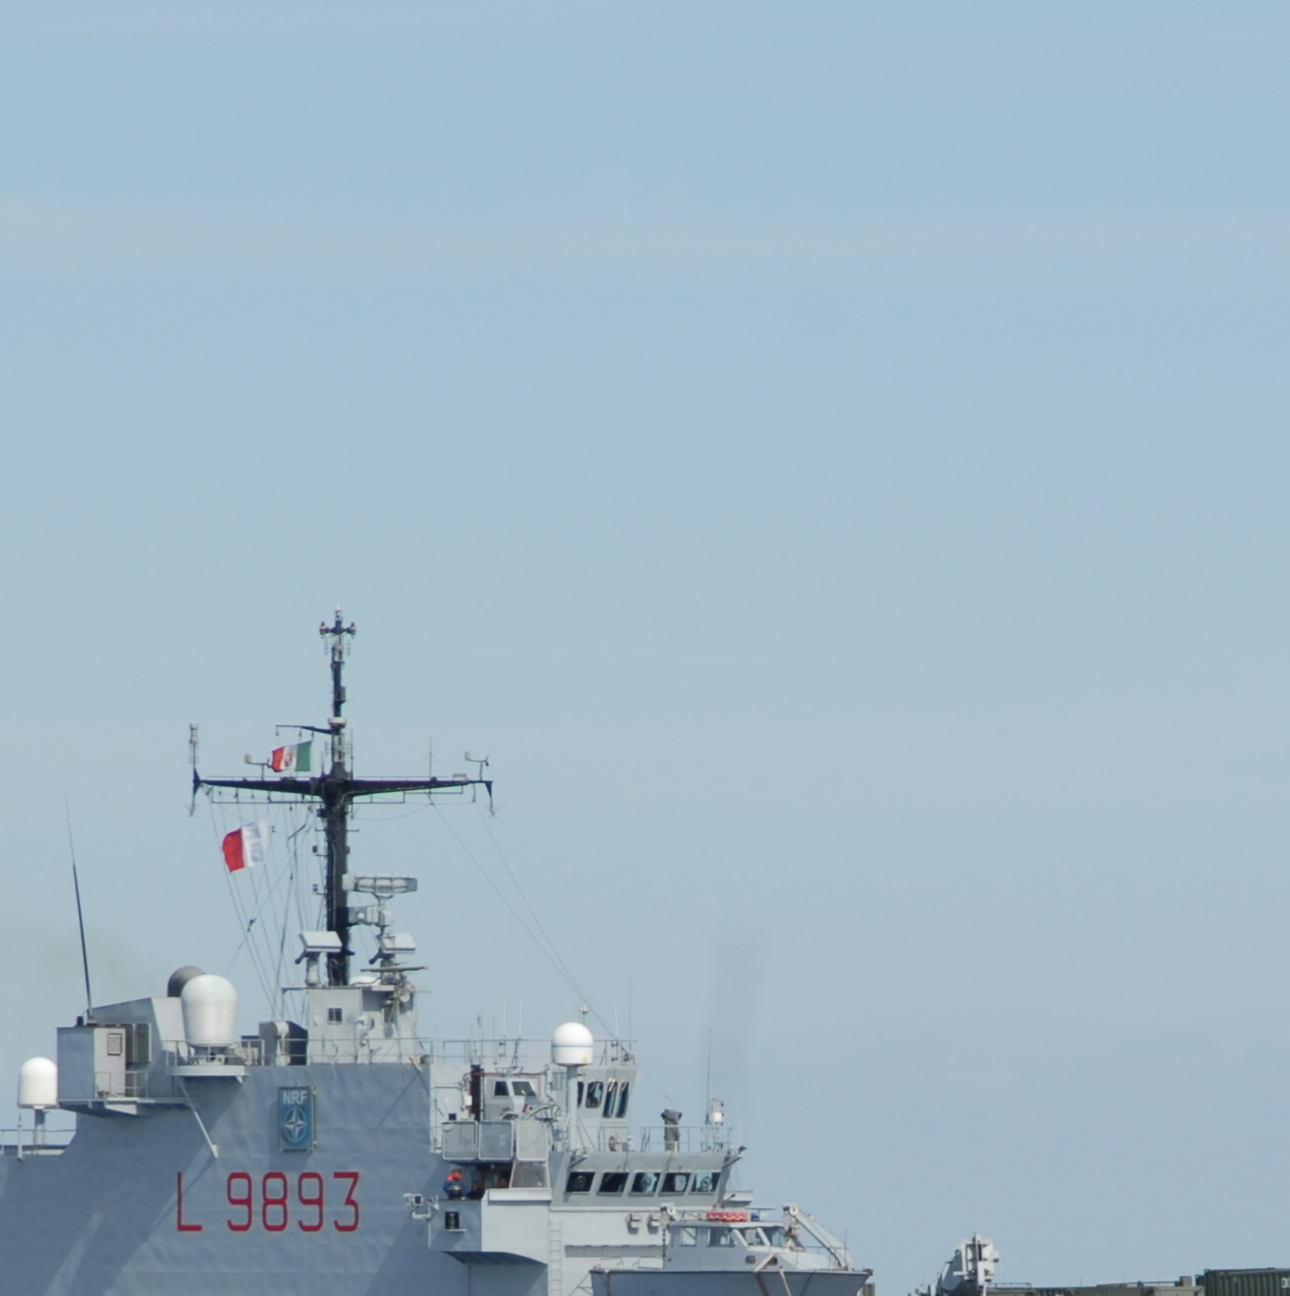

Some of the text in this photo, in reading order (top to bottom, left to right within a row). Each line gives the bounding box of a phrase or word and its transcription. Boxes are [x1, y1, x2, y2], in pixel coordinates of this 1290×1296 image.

[283, 1090, 307, 1105] NRF
[177, 1172, 359, 1232] L 9893
